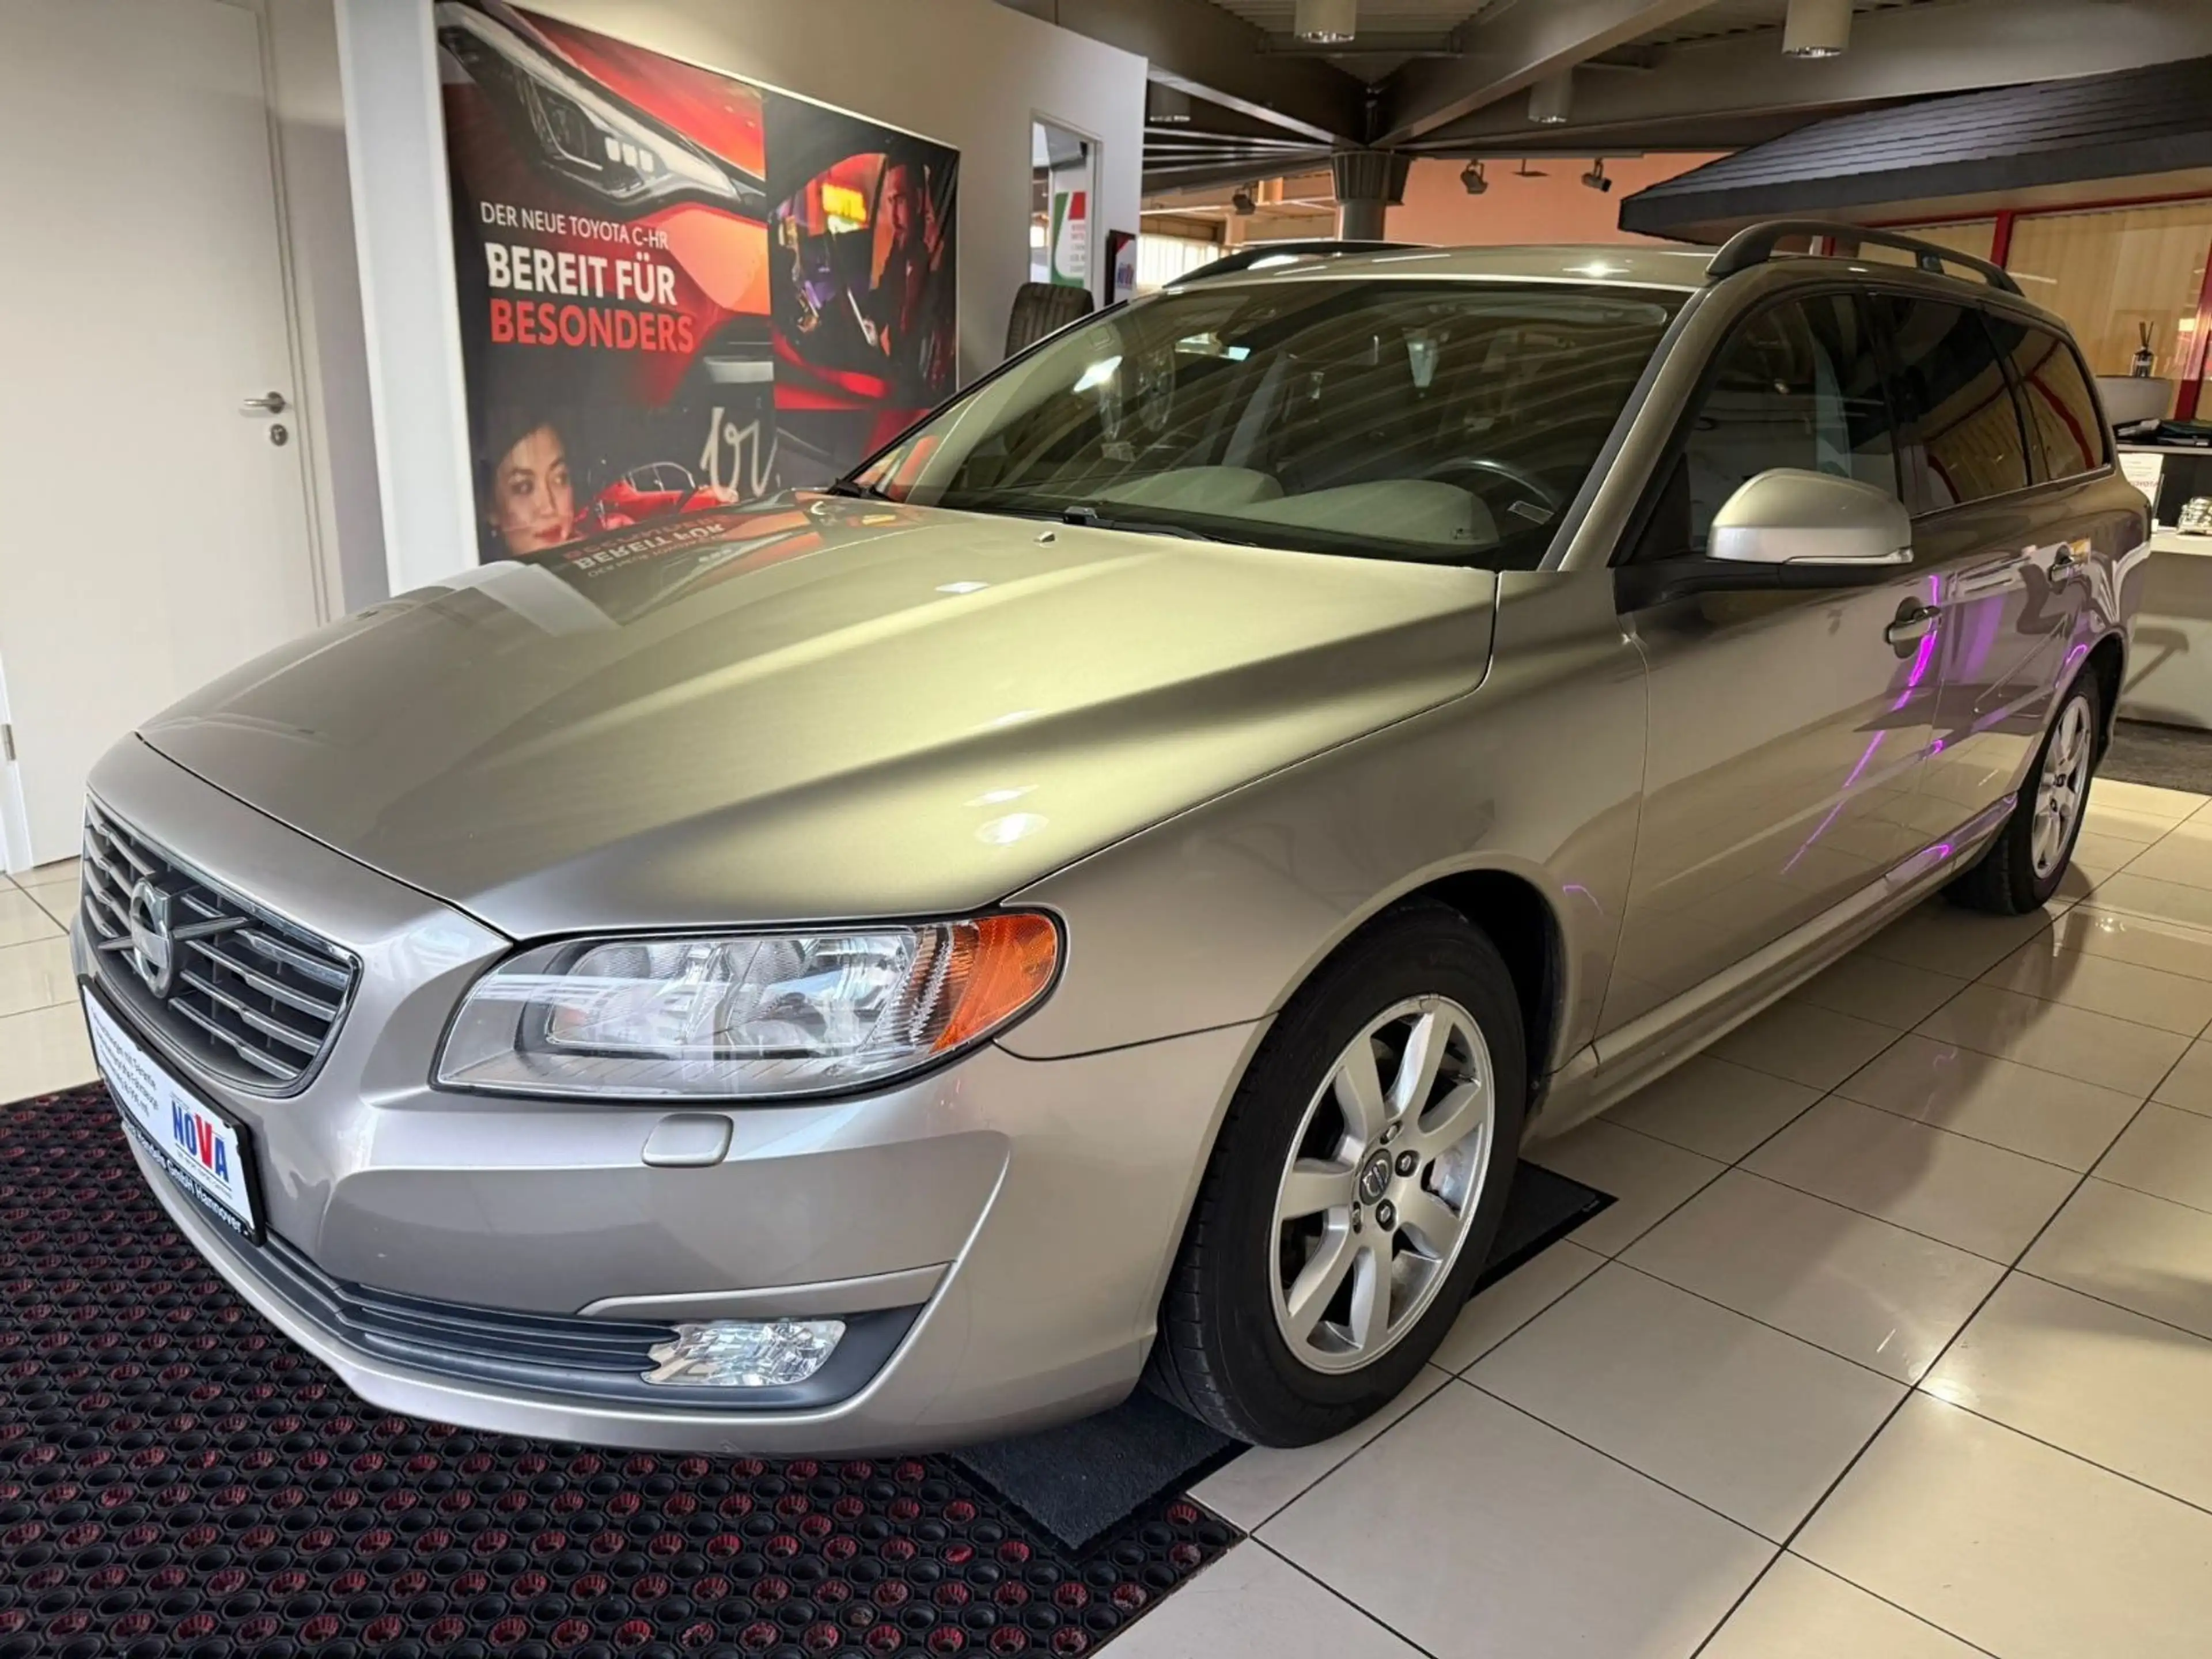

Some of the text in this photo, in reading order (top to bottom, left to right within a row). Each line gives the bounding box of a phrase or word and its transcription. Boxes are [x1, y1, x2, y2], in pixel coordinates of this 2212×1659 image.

[480, 201, 669, 249] DER NEUE TOYOTA C-HR
[484, 242, 677, 305] BEREIT FÜR
[489, 297, 694, 354] BESONDERS
[172, 1099, 229, 1183] NOVA
